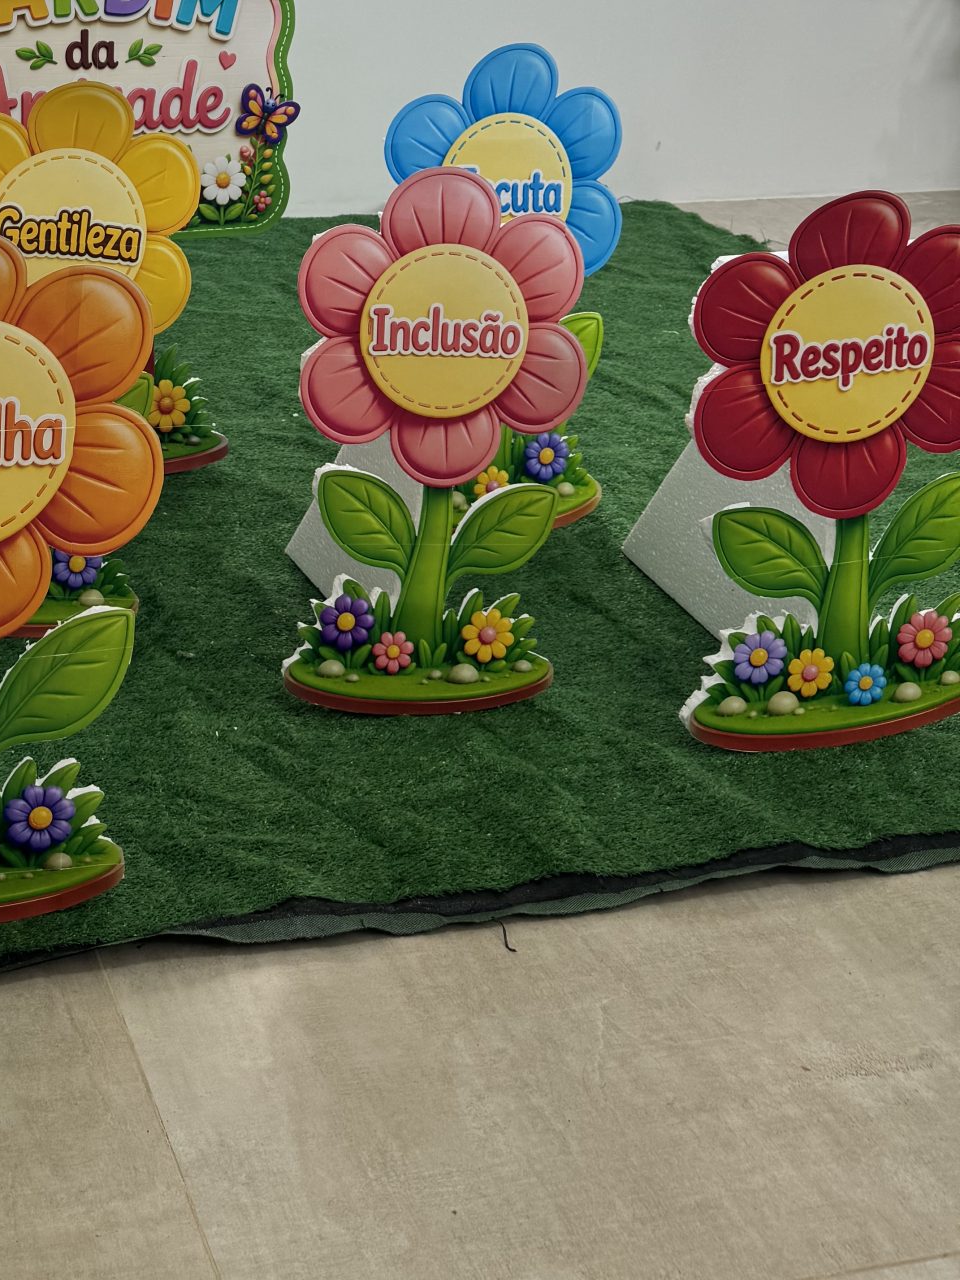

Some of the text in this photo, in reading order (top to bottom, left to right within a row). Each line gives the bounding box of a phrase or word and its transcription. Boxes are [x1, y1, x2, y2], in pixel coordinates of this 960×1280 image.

[64, 28, 119, 70] da
[464, 167, 562, 213] cuta
[371, 305, 521, 355] Inclusão
[772, 326, 929, 388] Respeito
